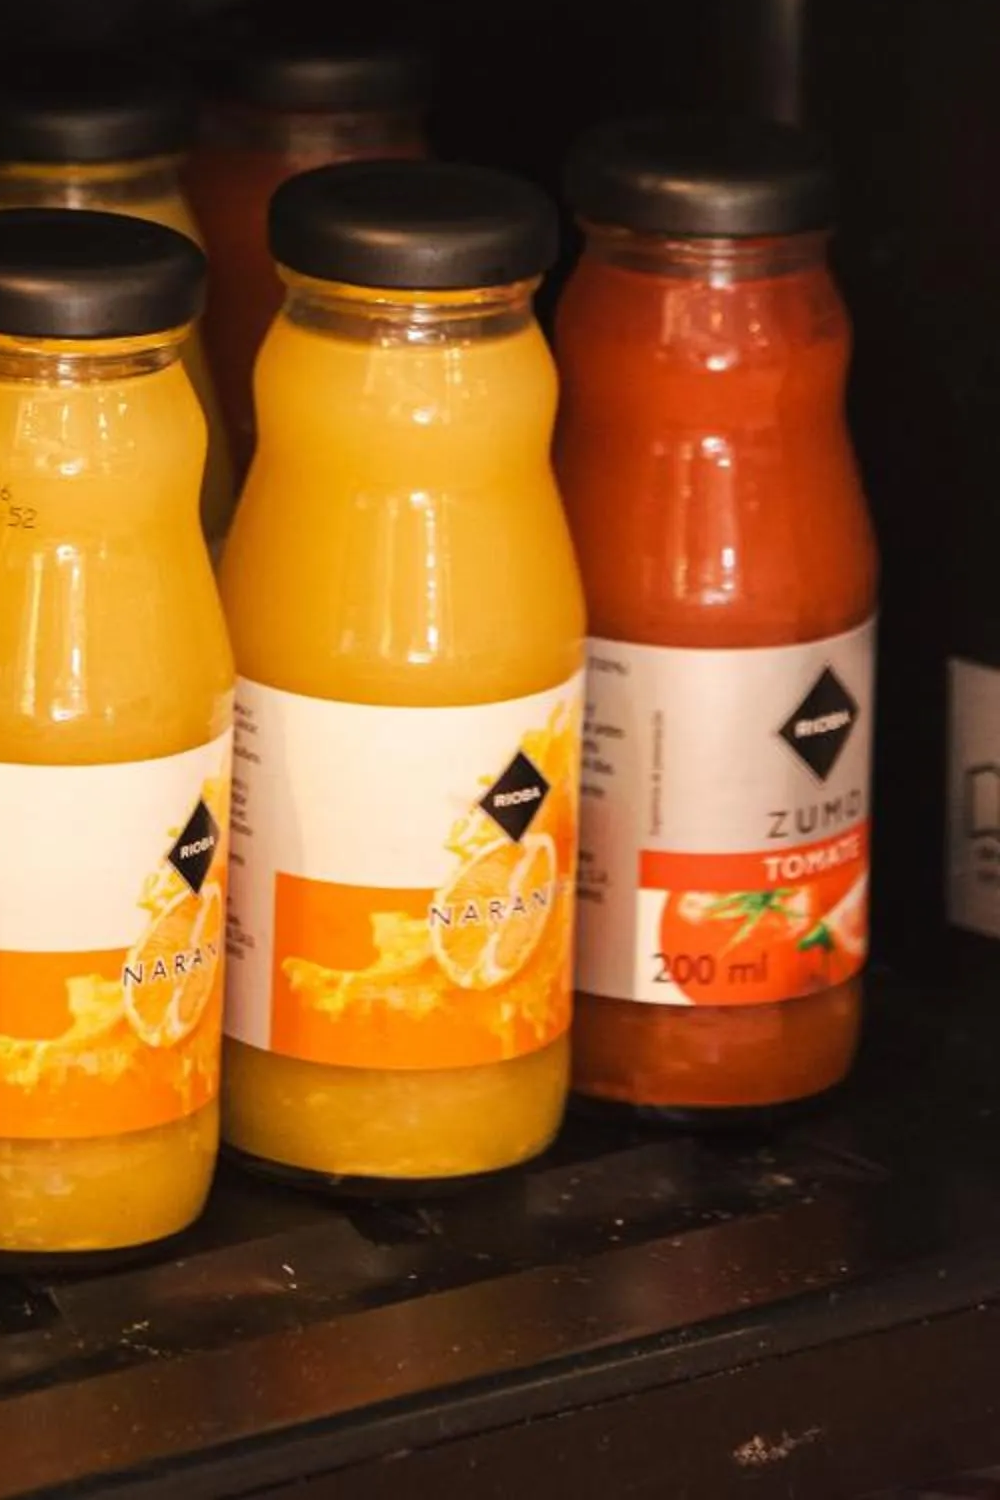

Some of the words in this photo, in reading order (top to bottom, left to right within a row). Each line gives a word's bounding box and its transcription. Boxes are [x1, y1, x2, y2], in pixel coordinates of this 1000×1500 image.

[7, 506, 38, 530] 52
[652, 953, 716, 984] 200
[727, 953, 769, 983] ml
